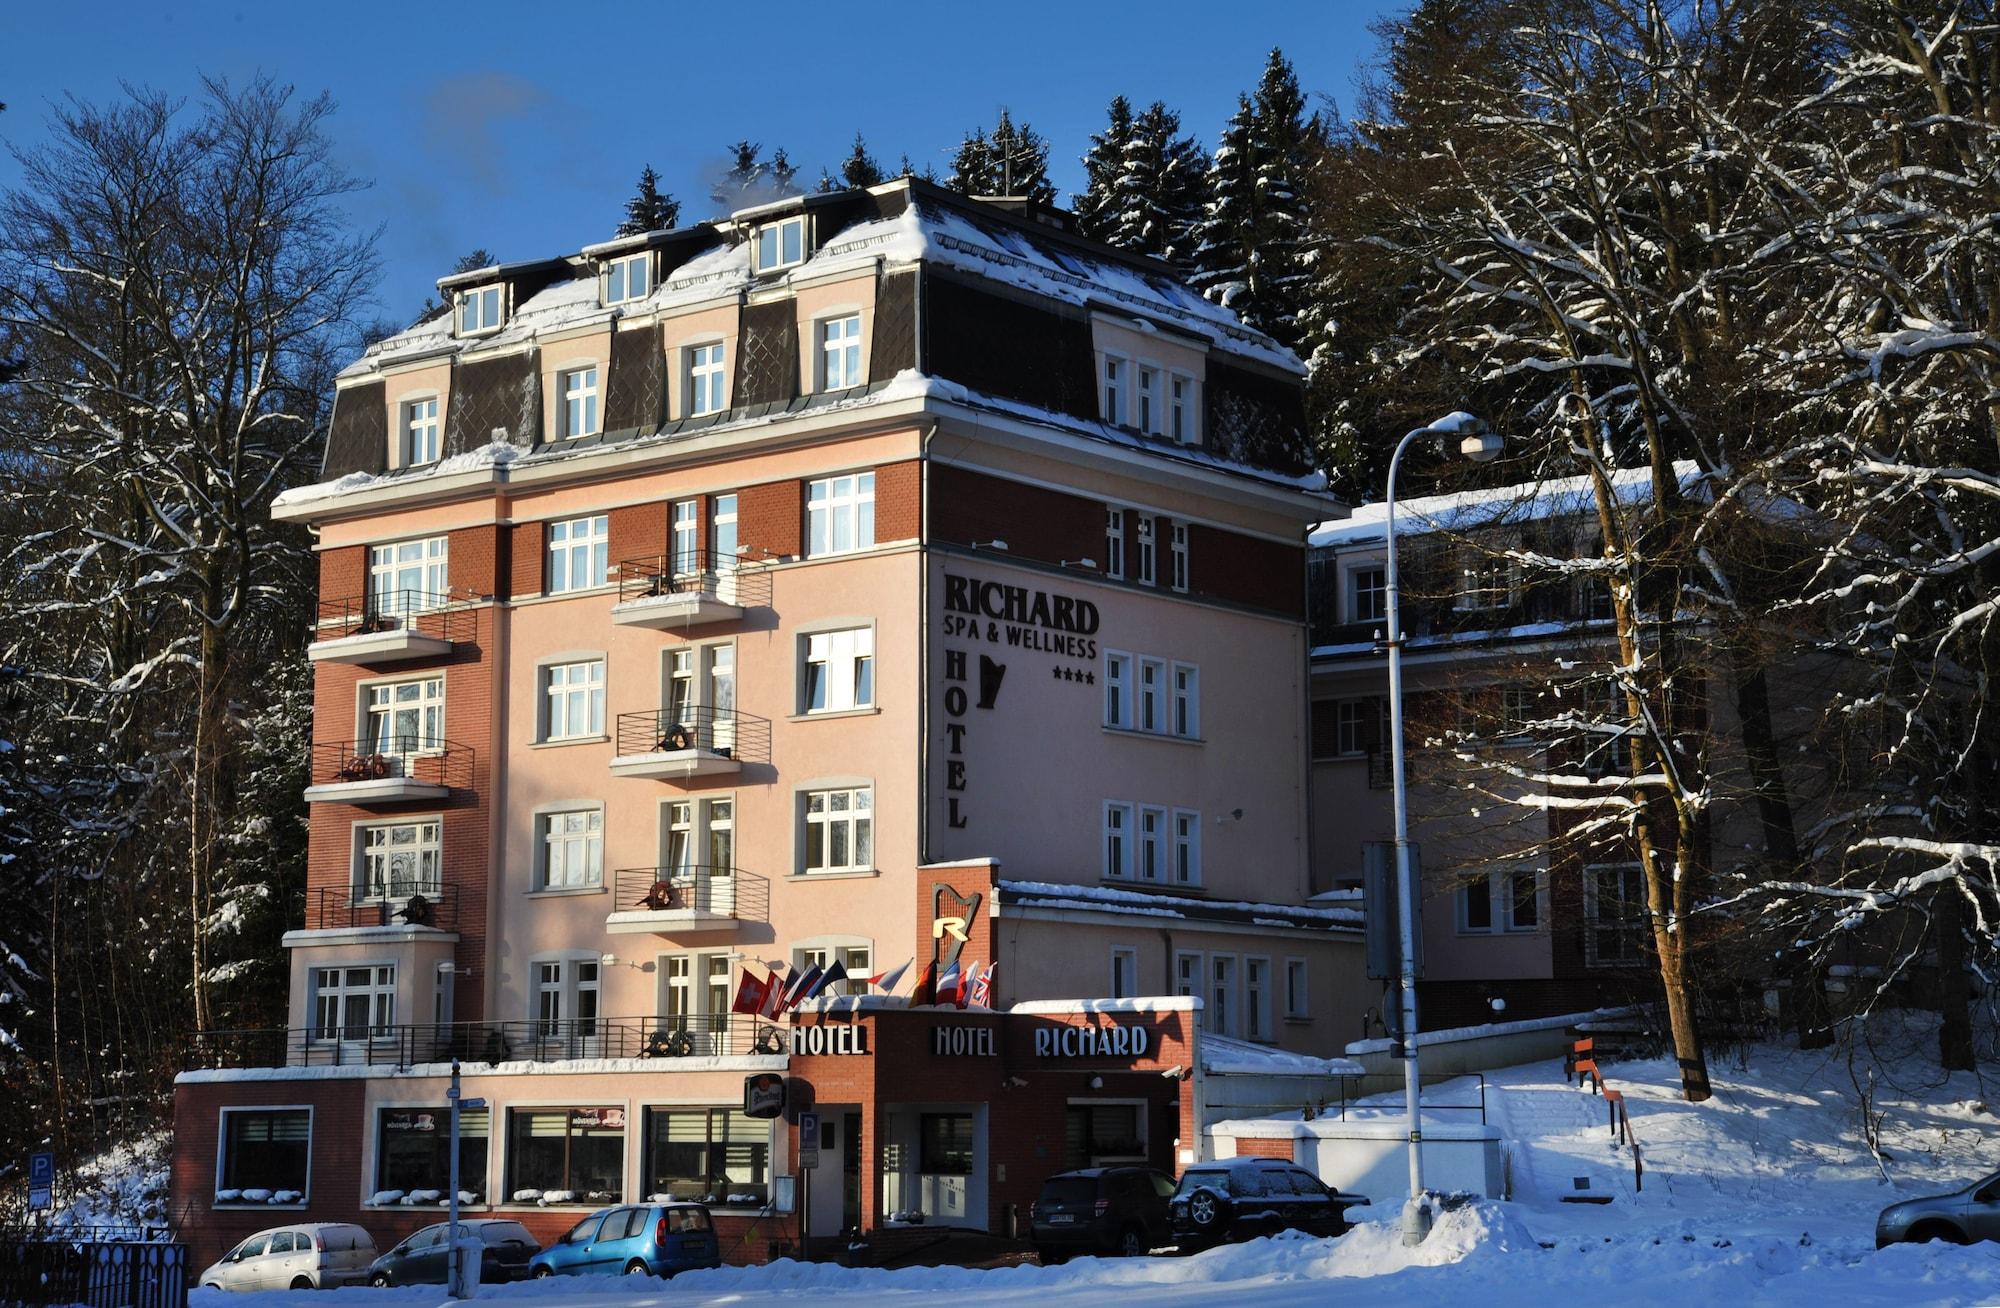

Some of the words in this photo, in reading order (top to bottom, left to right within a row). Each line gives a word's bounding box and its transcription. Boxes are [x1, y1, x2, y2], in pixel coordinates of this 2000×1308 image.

[944, 574, 1100, 636] RICHARD
[944, 614, 980, 640] SPA
[987, 622, 999, 643] &
[1006, 625, 1097, 660] WELLNESS
[945, 649, 968, 829] HOTEL
[933, 917, 969, 942] R
[790, 1024, 864, 1055] HOTEL
[936, 1026, 997, 1056] HOTEL
[1035, 1026, 1148, 1057] RICHARD
[804, 1117, 815, 1139] P
[35, 1157, 48, 1177] P
